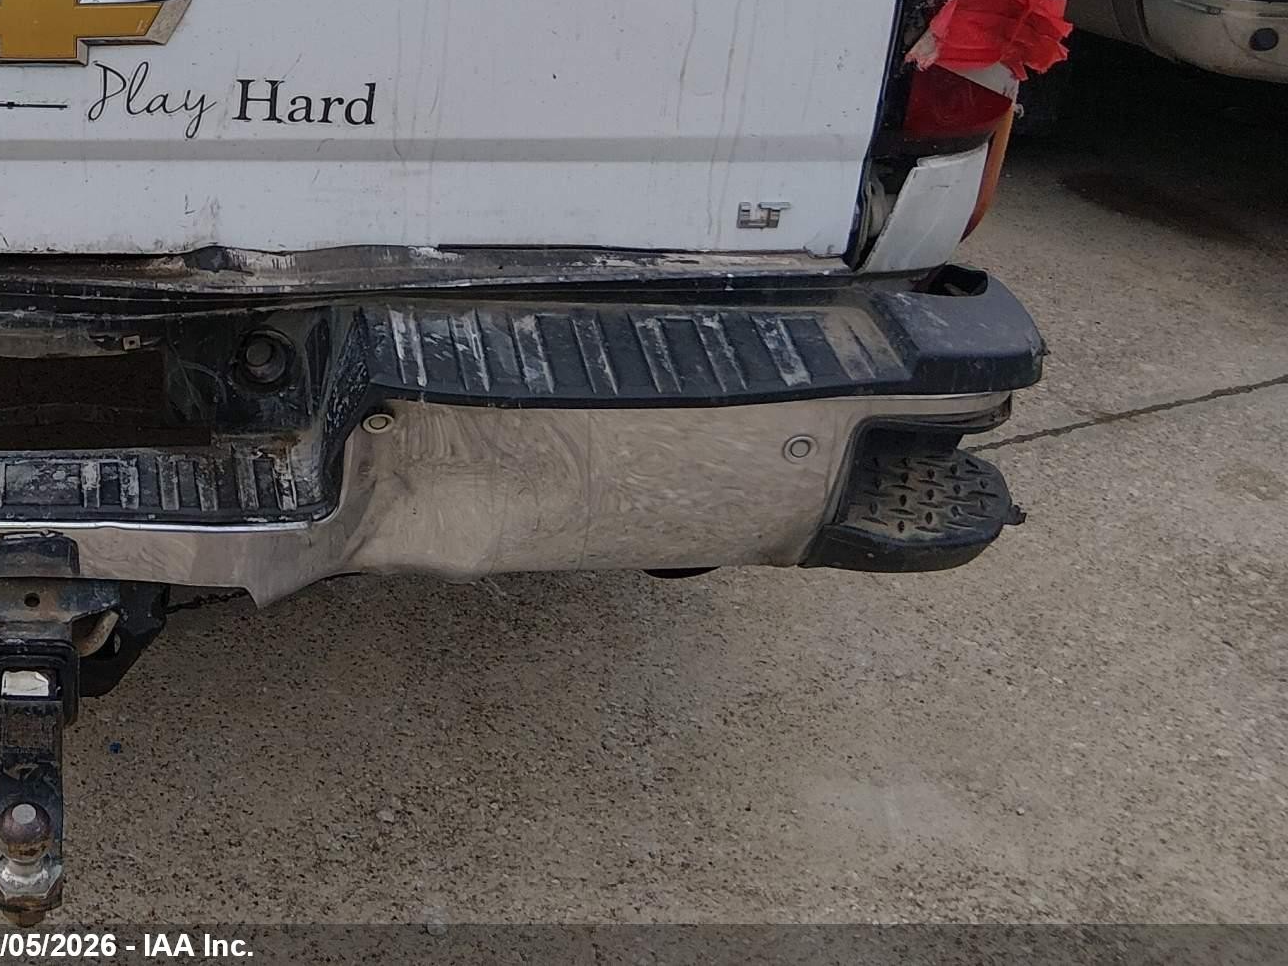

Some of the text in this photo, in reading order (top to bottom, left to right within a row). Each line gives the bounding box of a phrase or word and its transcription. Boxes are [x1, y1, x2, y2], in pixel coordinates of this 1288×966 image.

[87, 60, 217, 139] Play
[231, 78, 377, 126] Hard
[736, 201, 792, 229] LT
